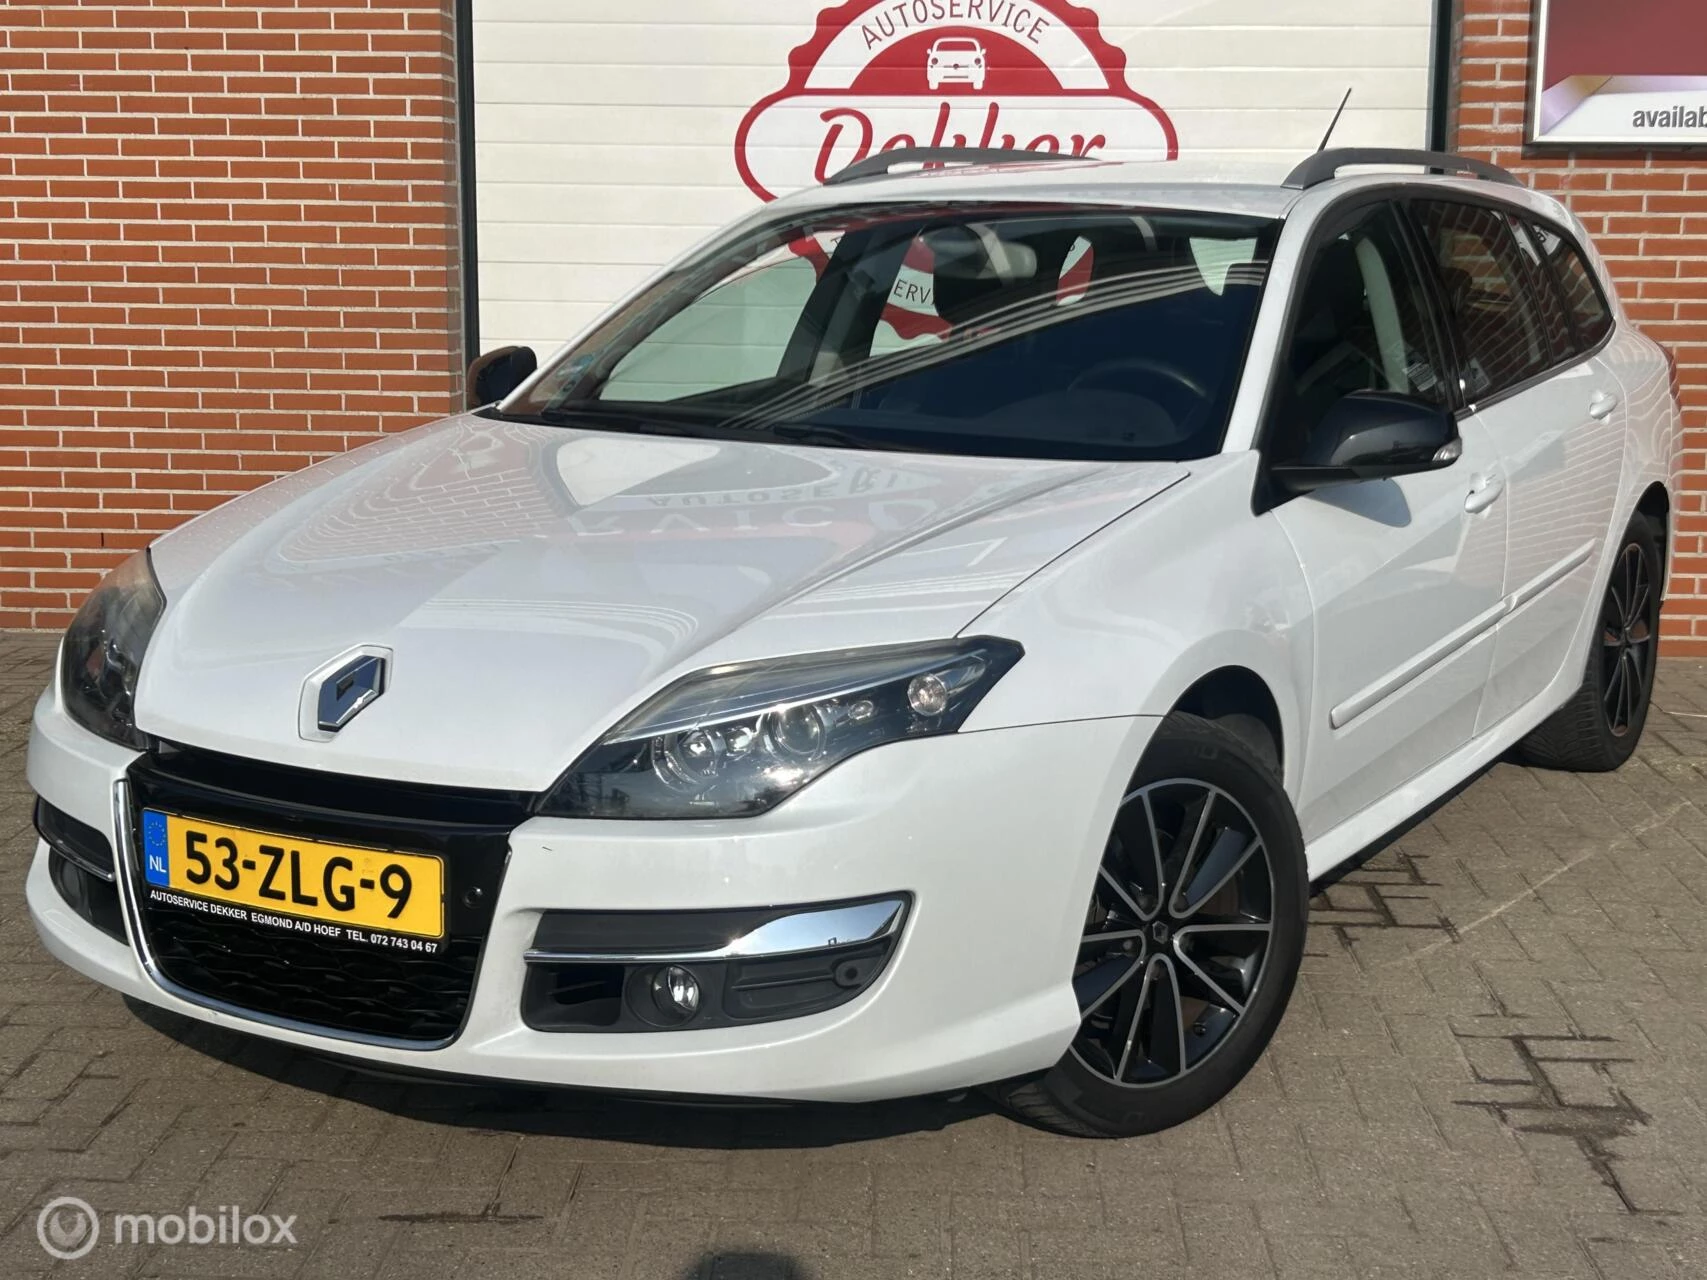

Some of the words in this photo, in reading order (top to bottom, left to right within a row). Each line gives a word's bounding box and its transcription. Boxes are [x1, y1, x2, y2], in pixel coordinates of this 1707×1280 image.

[861, 0, 1050, 50] AUTOSERVICE
[893, 278, 935, 305] ERV
[149, 854, 167, 873] NL
[185, 830, 412, 919] 53-ZLG-9
[150, 889, 208, 912] AUTOSERVICE
[210, 903, 247, 920] DEKKER
[251, 912, 293, 930] EGMOND
[294, 921, 311, 932] A/D
[313, 924, 341, 937] HOEF
[346, 929, 368, 942] TEL.
[370, 933, 388, 946] 072
[390, 936, 409, 949] 743
[410, 939, 423, 951] 04
[425, 942, 437, 953] 67
